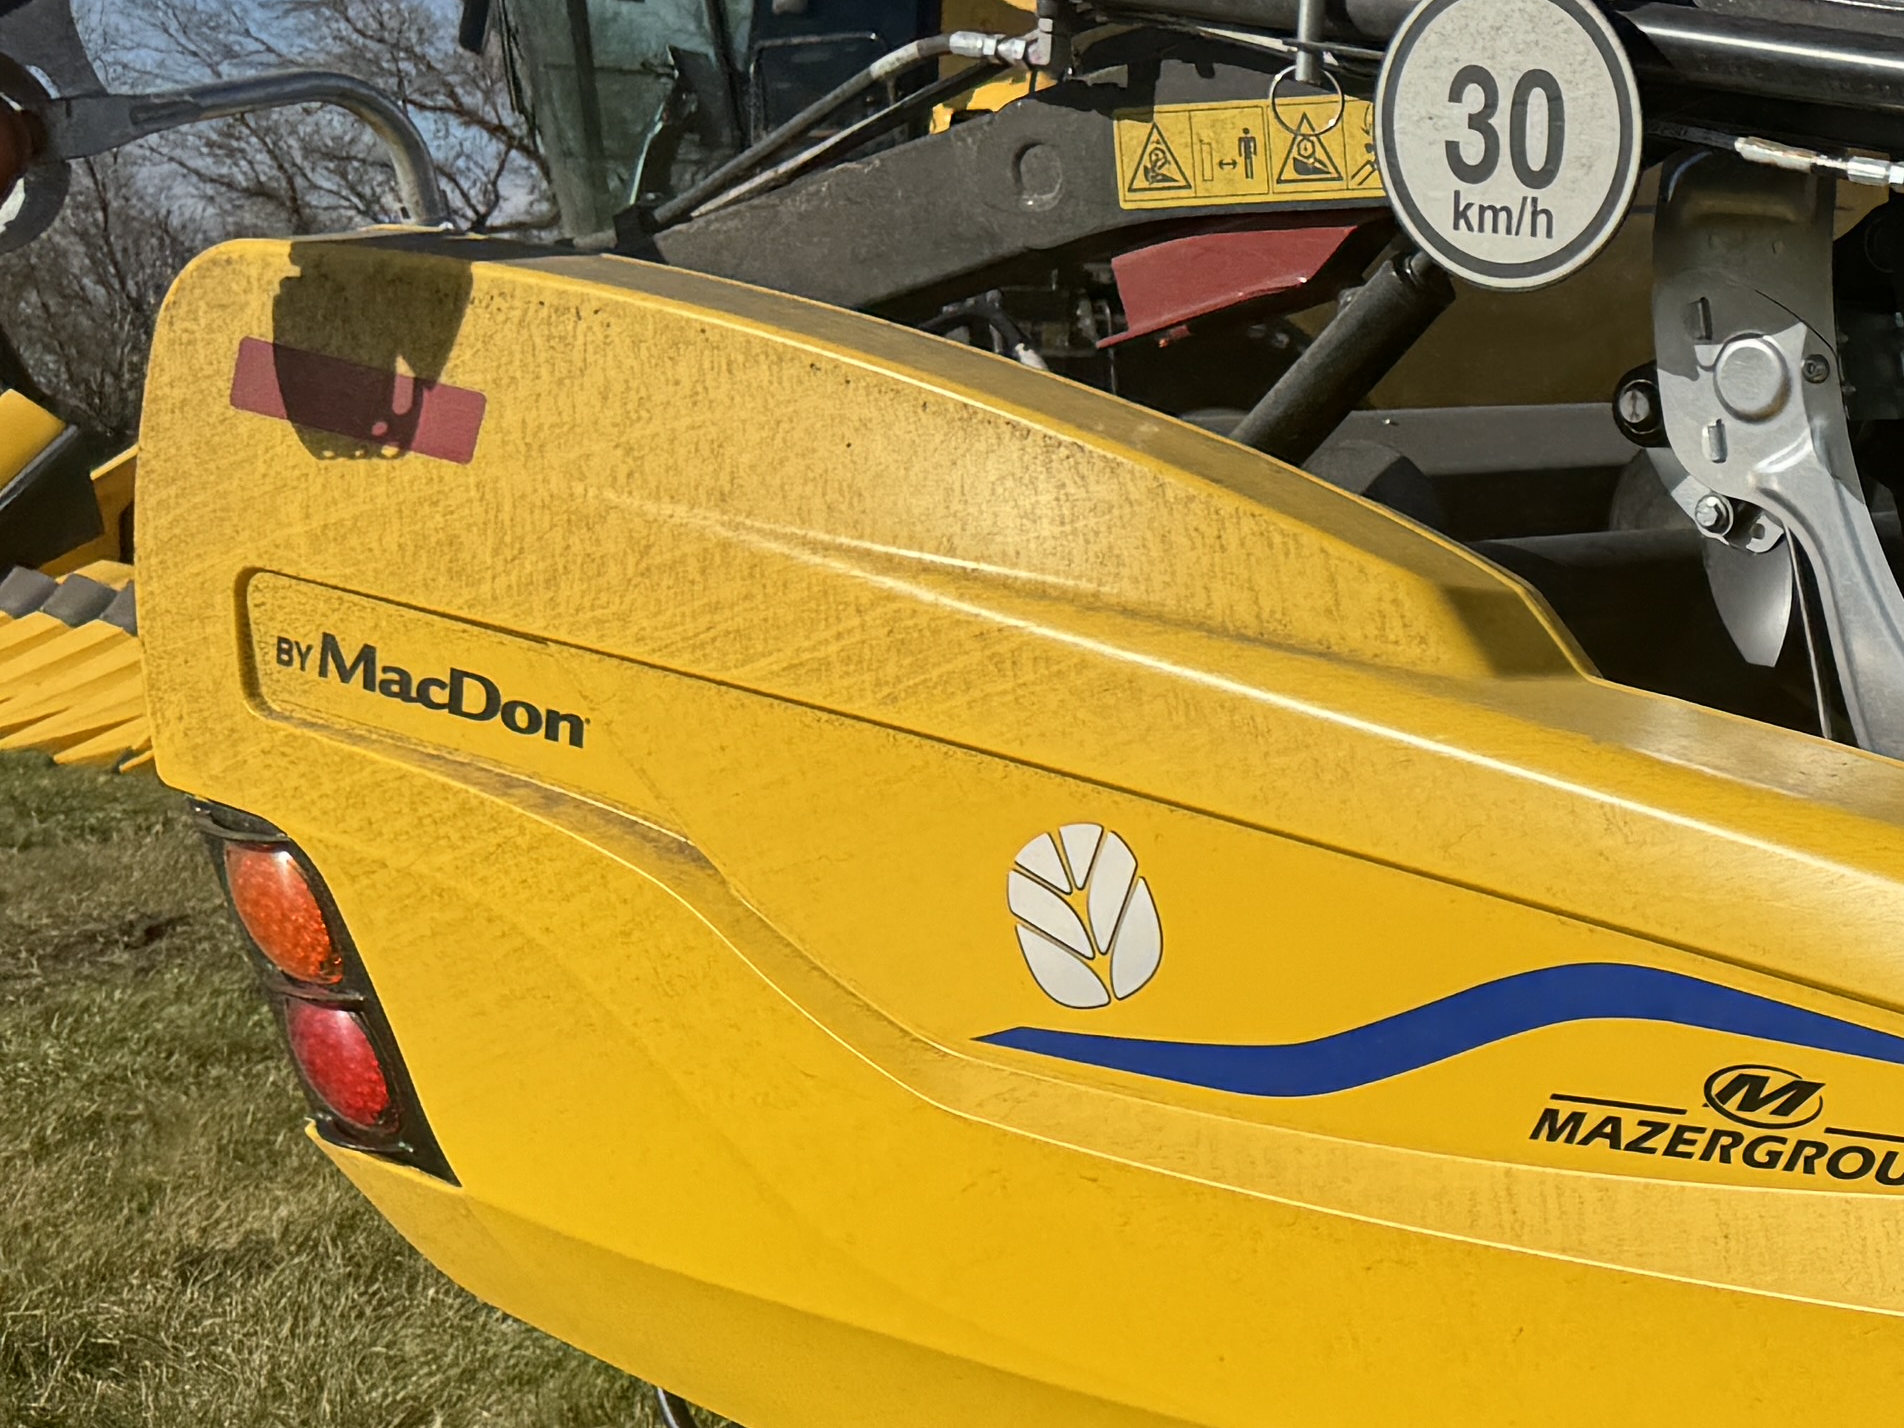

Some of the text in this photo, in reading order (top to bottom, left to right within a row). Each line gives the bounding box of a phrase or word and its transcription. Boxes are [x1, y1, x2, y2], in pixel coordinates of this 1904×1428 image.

[1444, 63, 1566, 190] 30
[1452, 189, 1554, 239] km/h
[275, 631, 585, 749] BY MacDon
